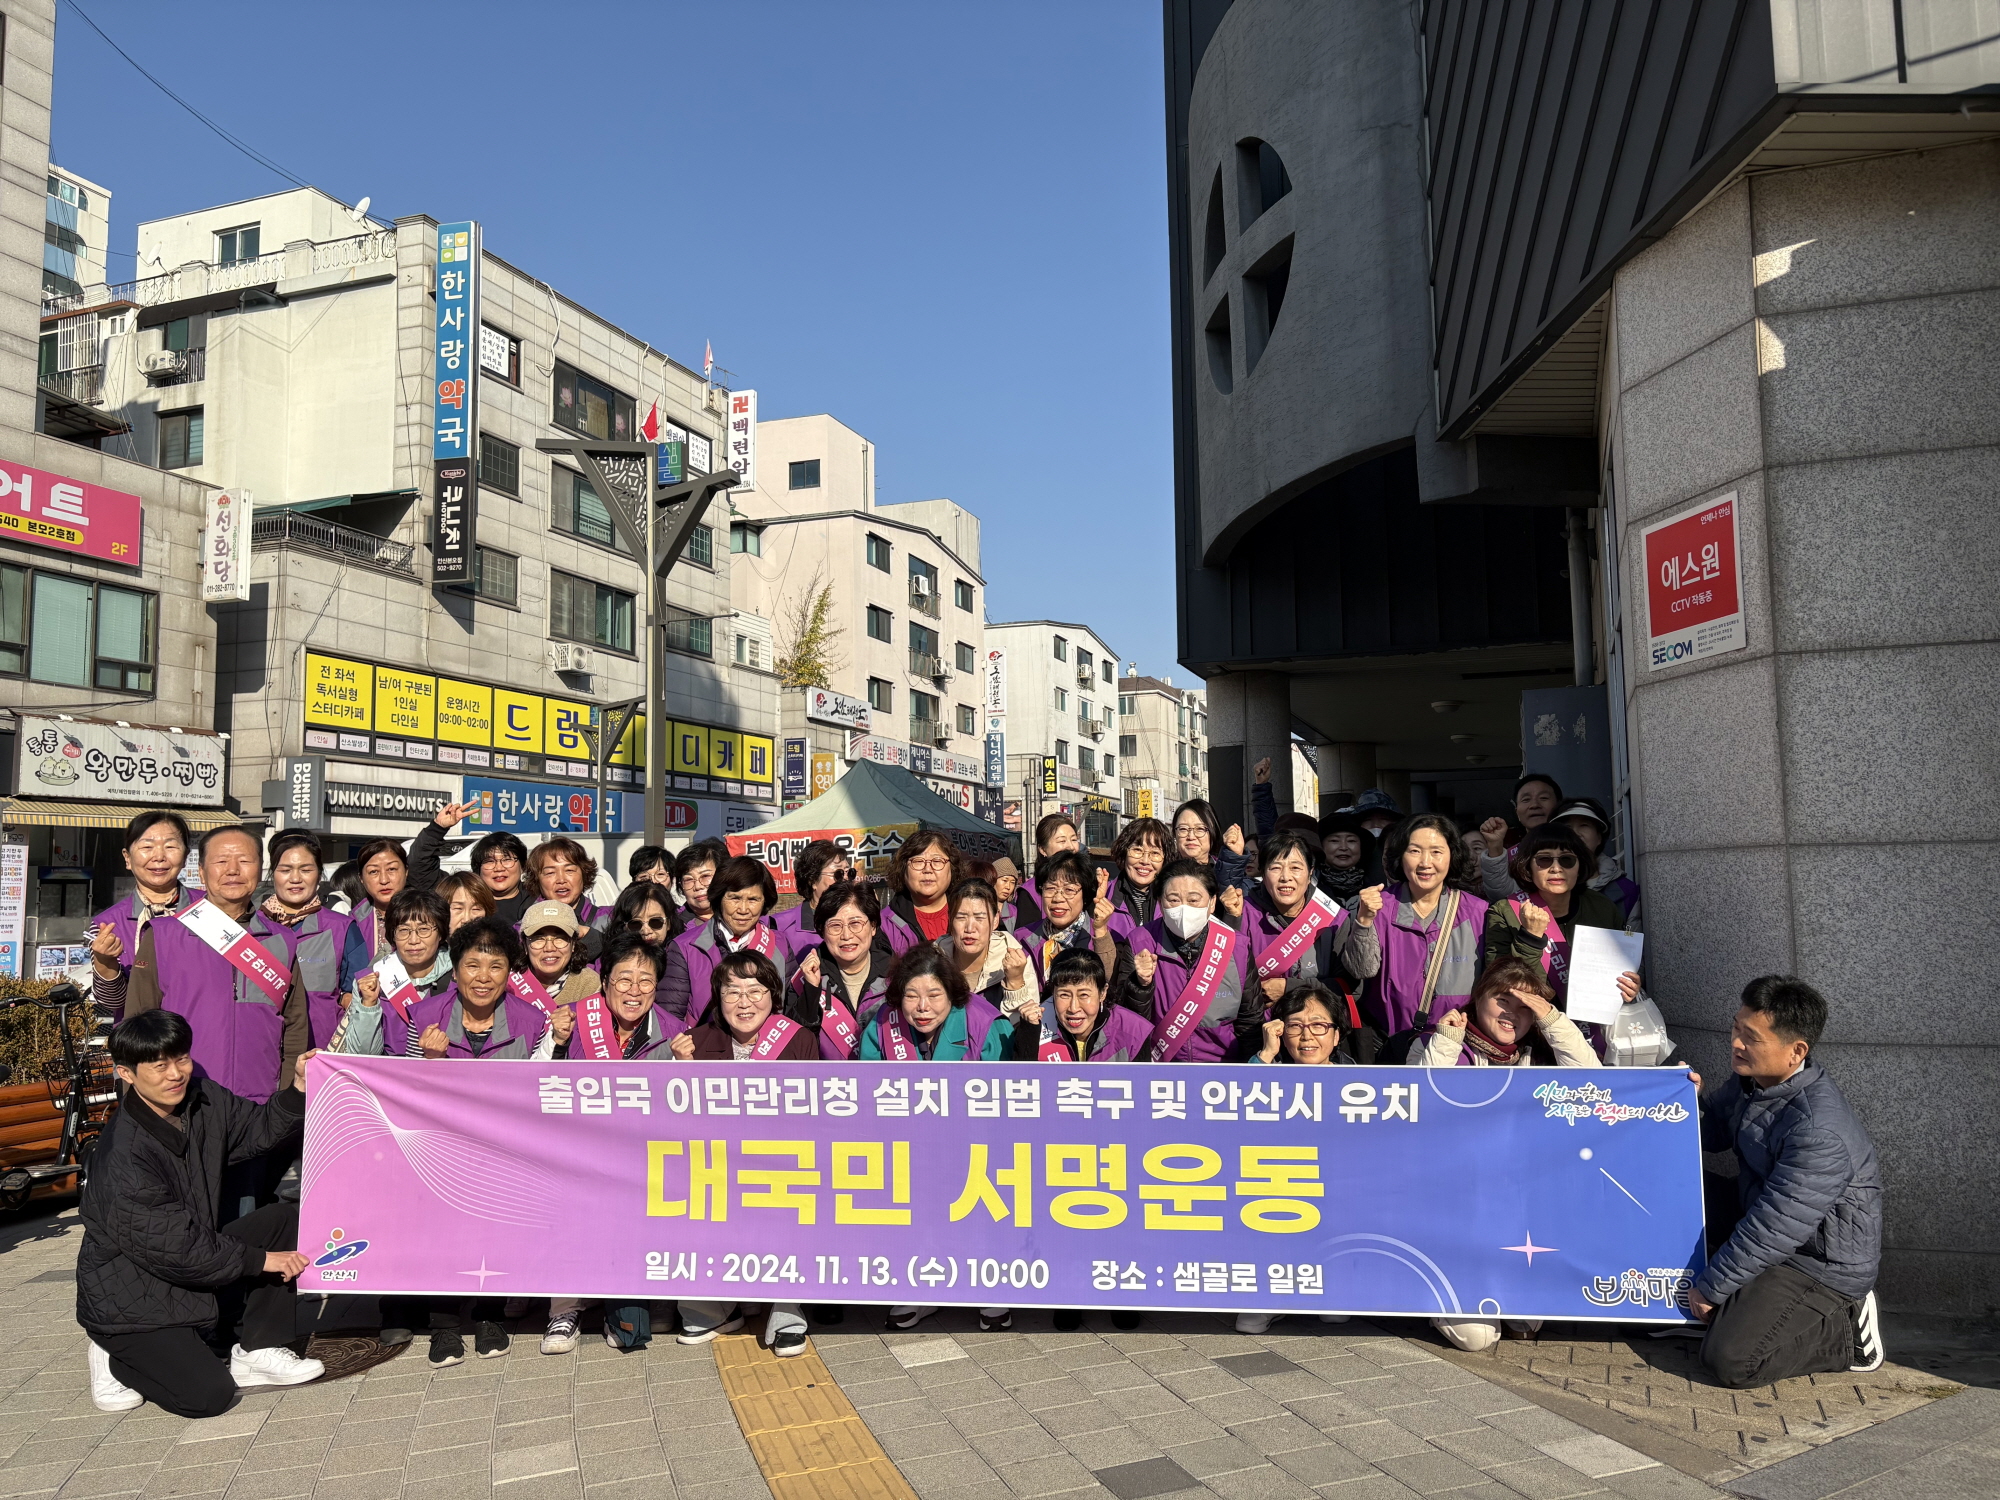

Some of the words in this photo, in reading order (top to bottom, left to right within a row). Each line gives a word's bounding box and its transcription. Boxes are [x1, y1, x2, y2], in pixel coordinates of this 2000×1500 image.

[438, 270, 466, 449] 한사랑약국
[731, 417, 750, 475] 백련암
[442, 485, 464, 550] 쿠니치
[111, 541, 128, 556] 2F
[213, 510, 232, 583] 선화당
[1660, 541, 1721, 591] 에스원
[1671, 597, 1691, 613] CCTV
[1691, 589, 1713, 607] 작동중
[1652, 639, 1693, 666] SECOM
[315, 682, 359, 702] 독서실형
[320, 664, 331, 680] 전
[334, 667, 355, 684] 좌석
[378, 675, 401, 692] 남/여
[404, 680, 432, 697] 구분된
[311, 700, 365, 721] 스터디카페
[390, 712, 419, 729] 다인실
[393, 695, 418, 712] 1인실
[439, 712, 490, 730] 09:00~02:00
[445, 696, 481, 714] 운영시간
[504, 703, 580, 750] 드림
[291, 763, 302, 821] DONUTS
[301, 762, 312, 822] DUNKIN'
[328, 789, 381, 809] UNKIN'
[383, 794, 444, 814] DONUTS
[1280, 912, 1322, 958] 대한민국
[1196, 932, 1228, 997] 대한민국
[586, 997, 610, 1059] 대한민국
[757, 1019, 791, 1056] 이민청
[888, 1009, 908, 1060] 이민청
[1166, 1000, 1199, 1039] 이민청
[538, 1075, 652, 1115] 출입국
[666, 1077, 859, 1117] 이민관리청
[872, 1078, 950, 1117] 설치
[963, 1079, 1042, 1118] 입법
[1055, 1078, 1136, 1119] 촉구
[1149, 1080, 1187, 1121] 및
[1201, 1081, 1323, 1121] 안산시
[1338, 1083, 1420, 1123] 유치
[1647, 1103, 1689, 1122] 안산
[645, 1139, 912, 1228] 대국민
[949, 1142, 1326, 1234] 서명운동
[321, 1269, 358, 1281] 안산시
[644, 1251, 698, 1282] 일시
[722, 1253, 802, 1285] 2024.
[815, 1255, 843, 1285] 11.
[858, 1256, 899, 1286] 13.
[906, 1256, 958, 1289] (수)
[966, 1257, 1050, 1290] 10:00
[1091, 1260, 1147, 1292] 장소
[1173, 1261, 1259, 1294] 샘골로
[1266, 1263, 1325, 1296] 일원
